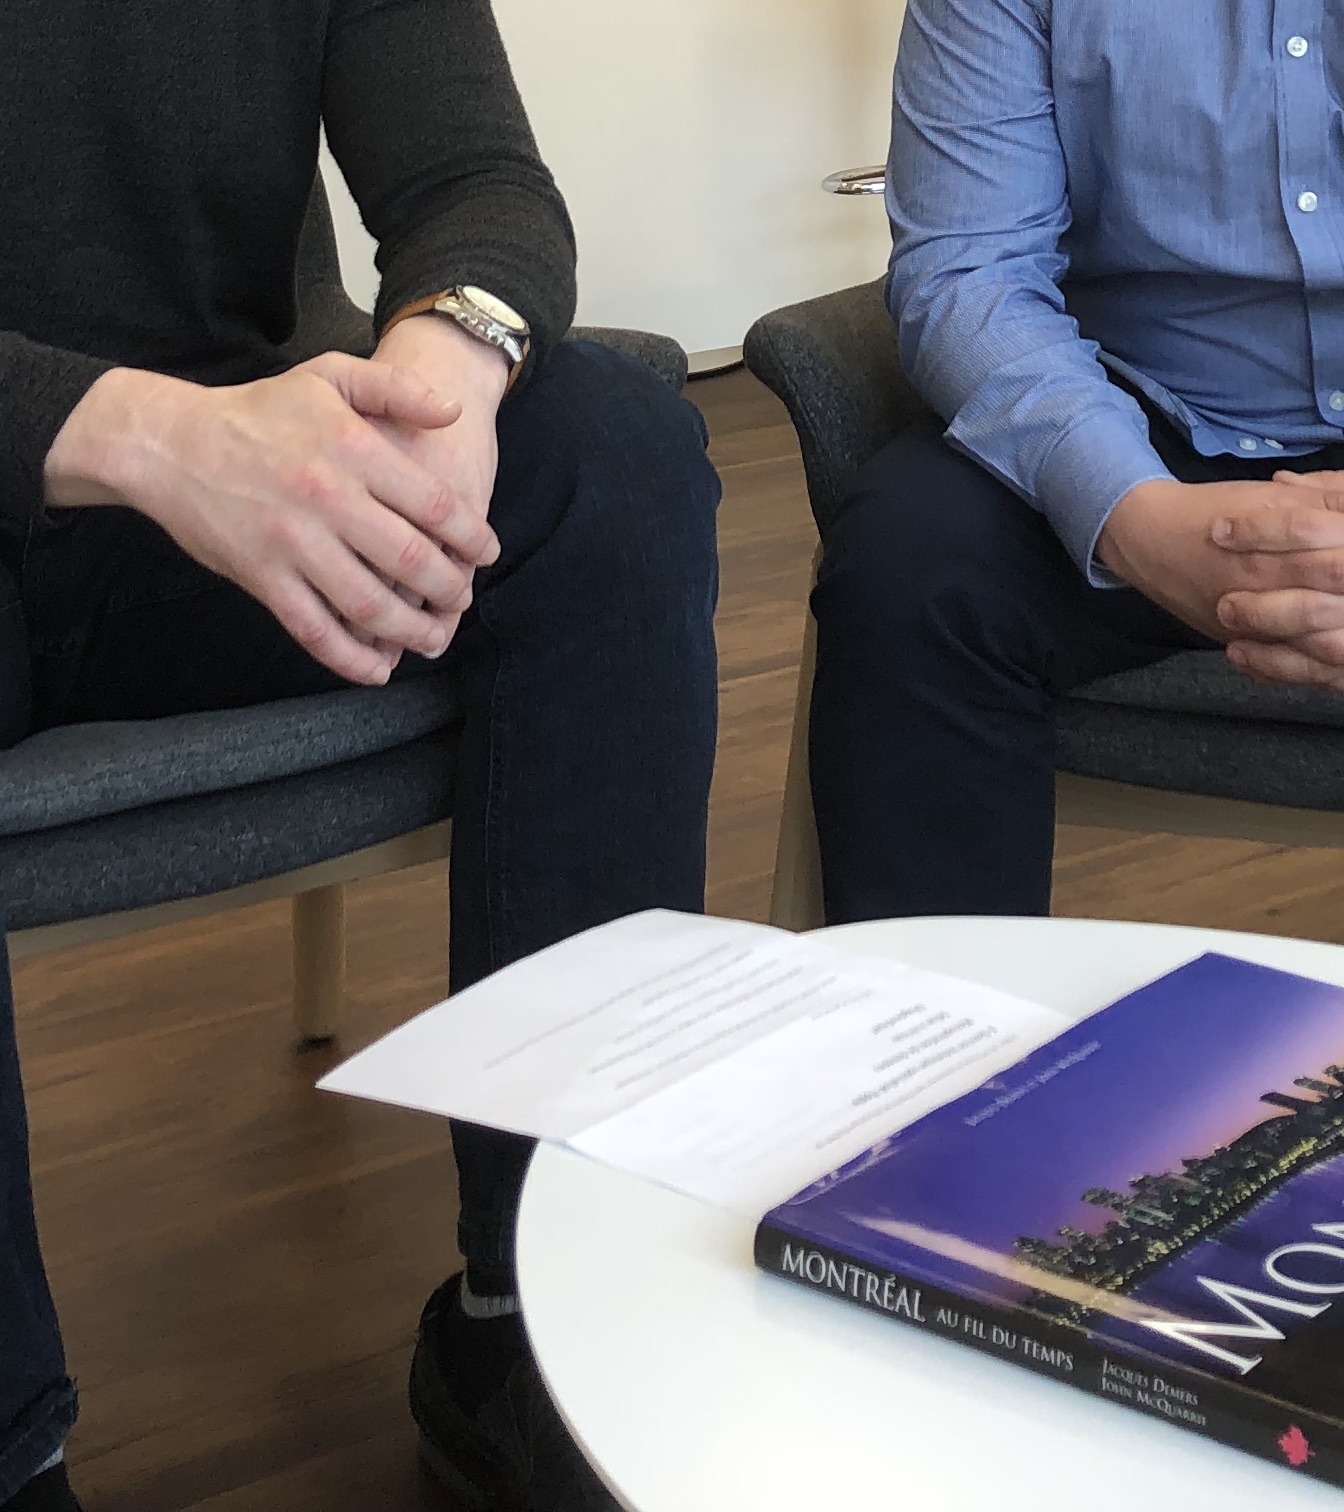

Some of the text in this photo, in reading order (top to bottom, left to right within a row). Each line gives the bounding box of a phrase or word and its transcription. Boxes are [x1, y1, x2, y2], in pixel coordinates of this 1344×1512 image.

[782, 1241, 1075, 1371] MONTRÉAL AU FIL DU TEMPS
